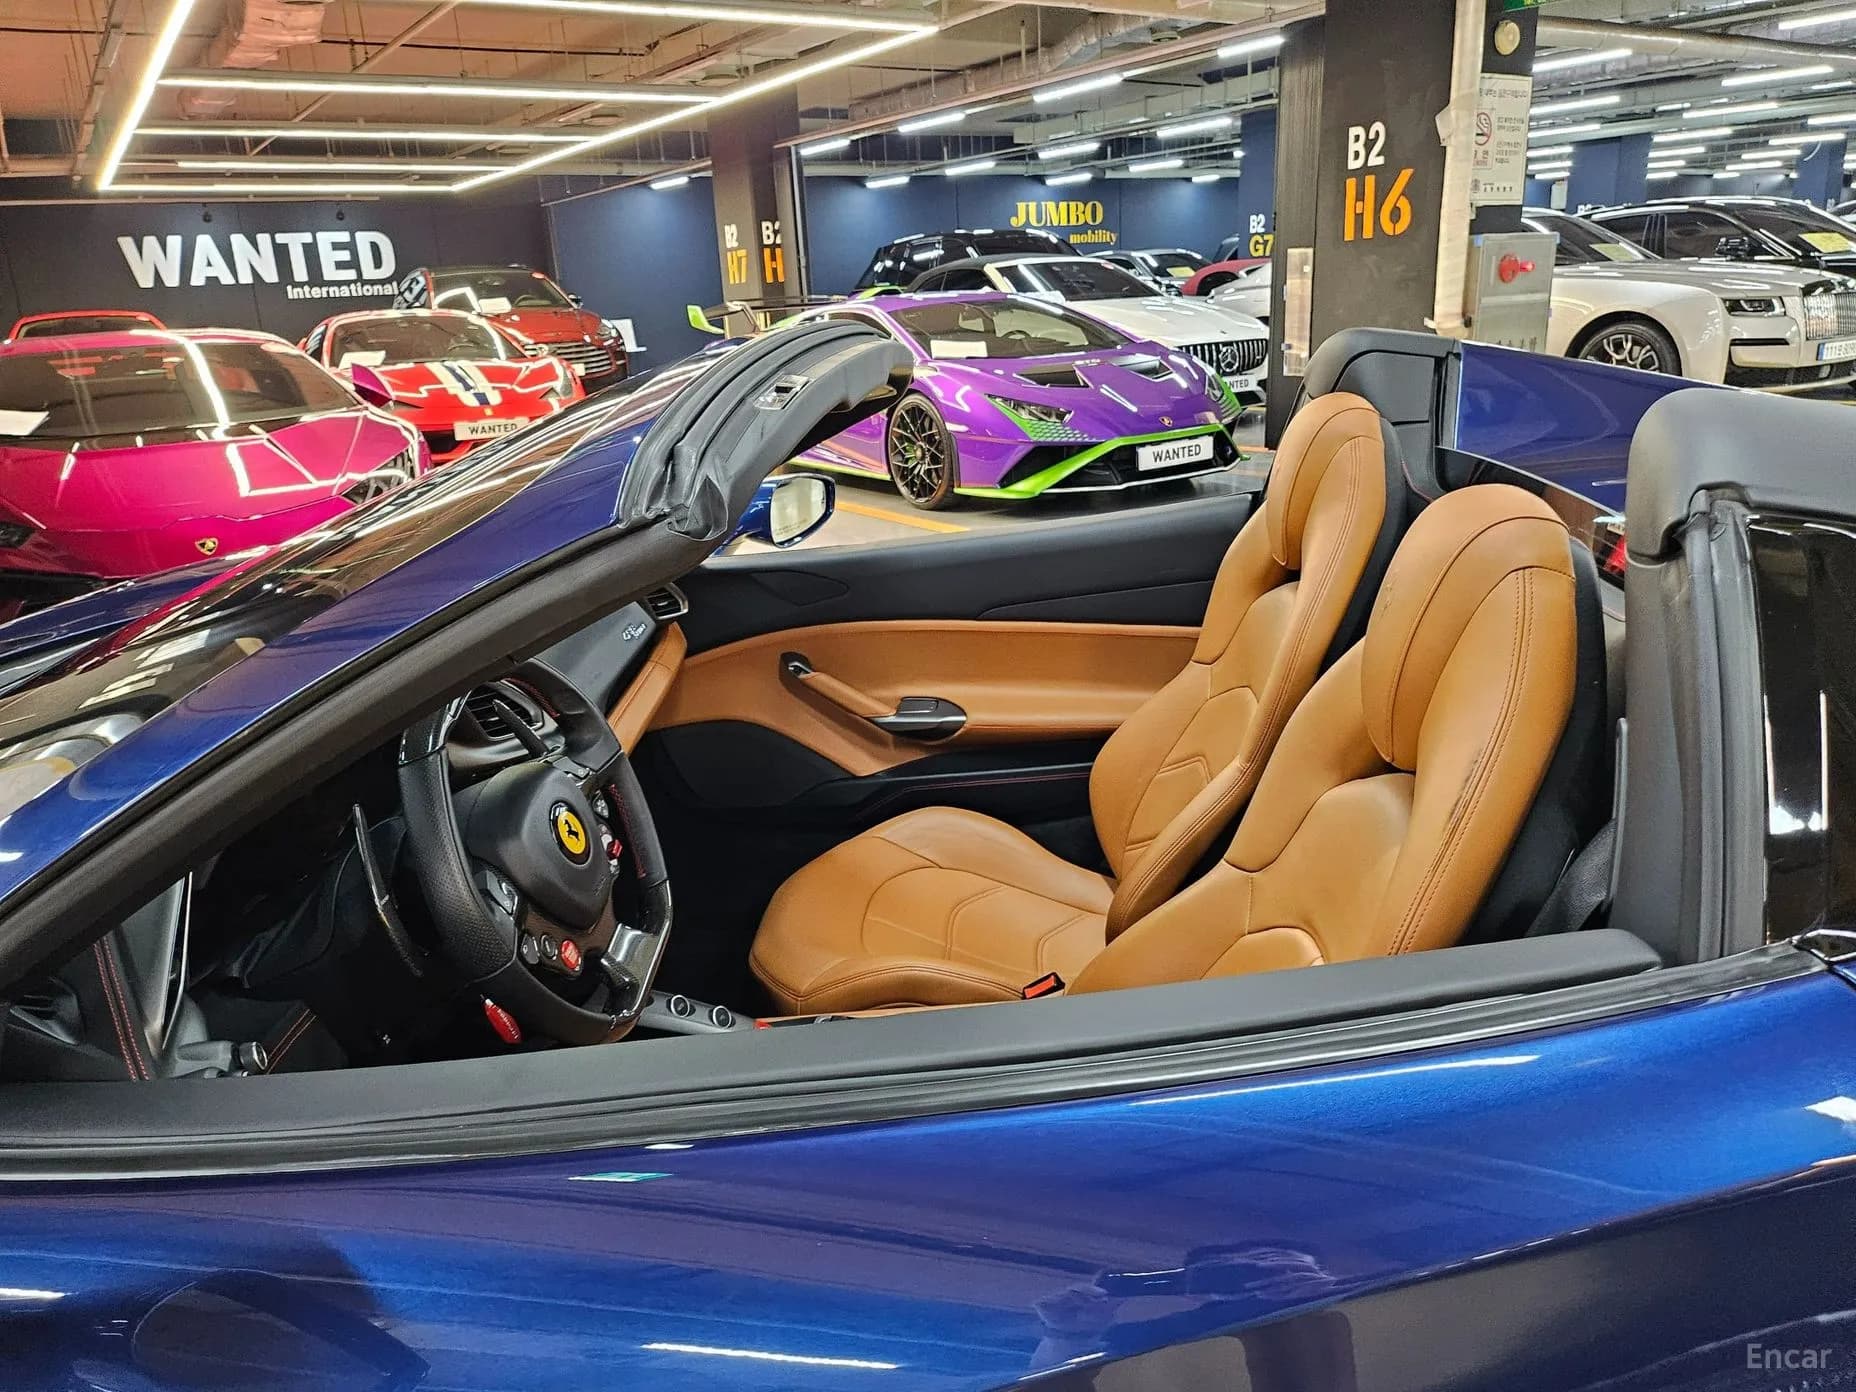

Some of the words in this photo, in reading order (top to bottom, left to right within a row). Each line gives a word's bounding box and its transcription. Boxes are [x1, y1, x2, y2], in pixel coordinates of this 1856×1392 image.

[1347, 121, 1386, 170] B2
[1010, 201, 1103, 227] JUMBO
[1344, 168, 1415, 241] H6
[1250, 213, 1266, 233] B2
[1069, 229, 1118, 245] mobility
[1249, 234, 1274, 257] G7
[117, 231, 397, 289] WANTED
[287, 280, 399, 299] International
[1225, 379, 1249, 389] NTED
[468, 423, 518, 435] WANTED
[1152, 444, 1201, 463] WANTED
